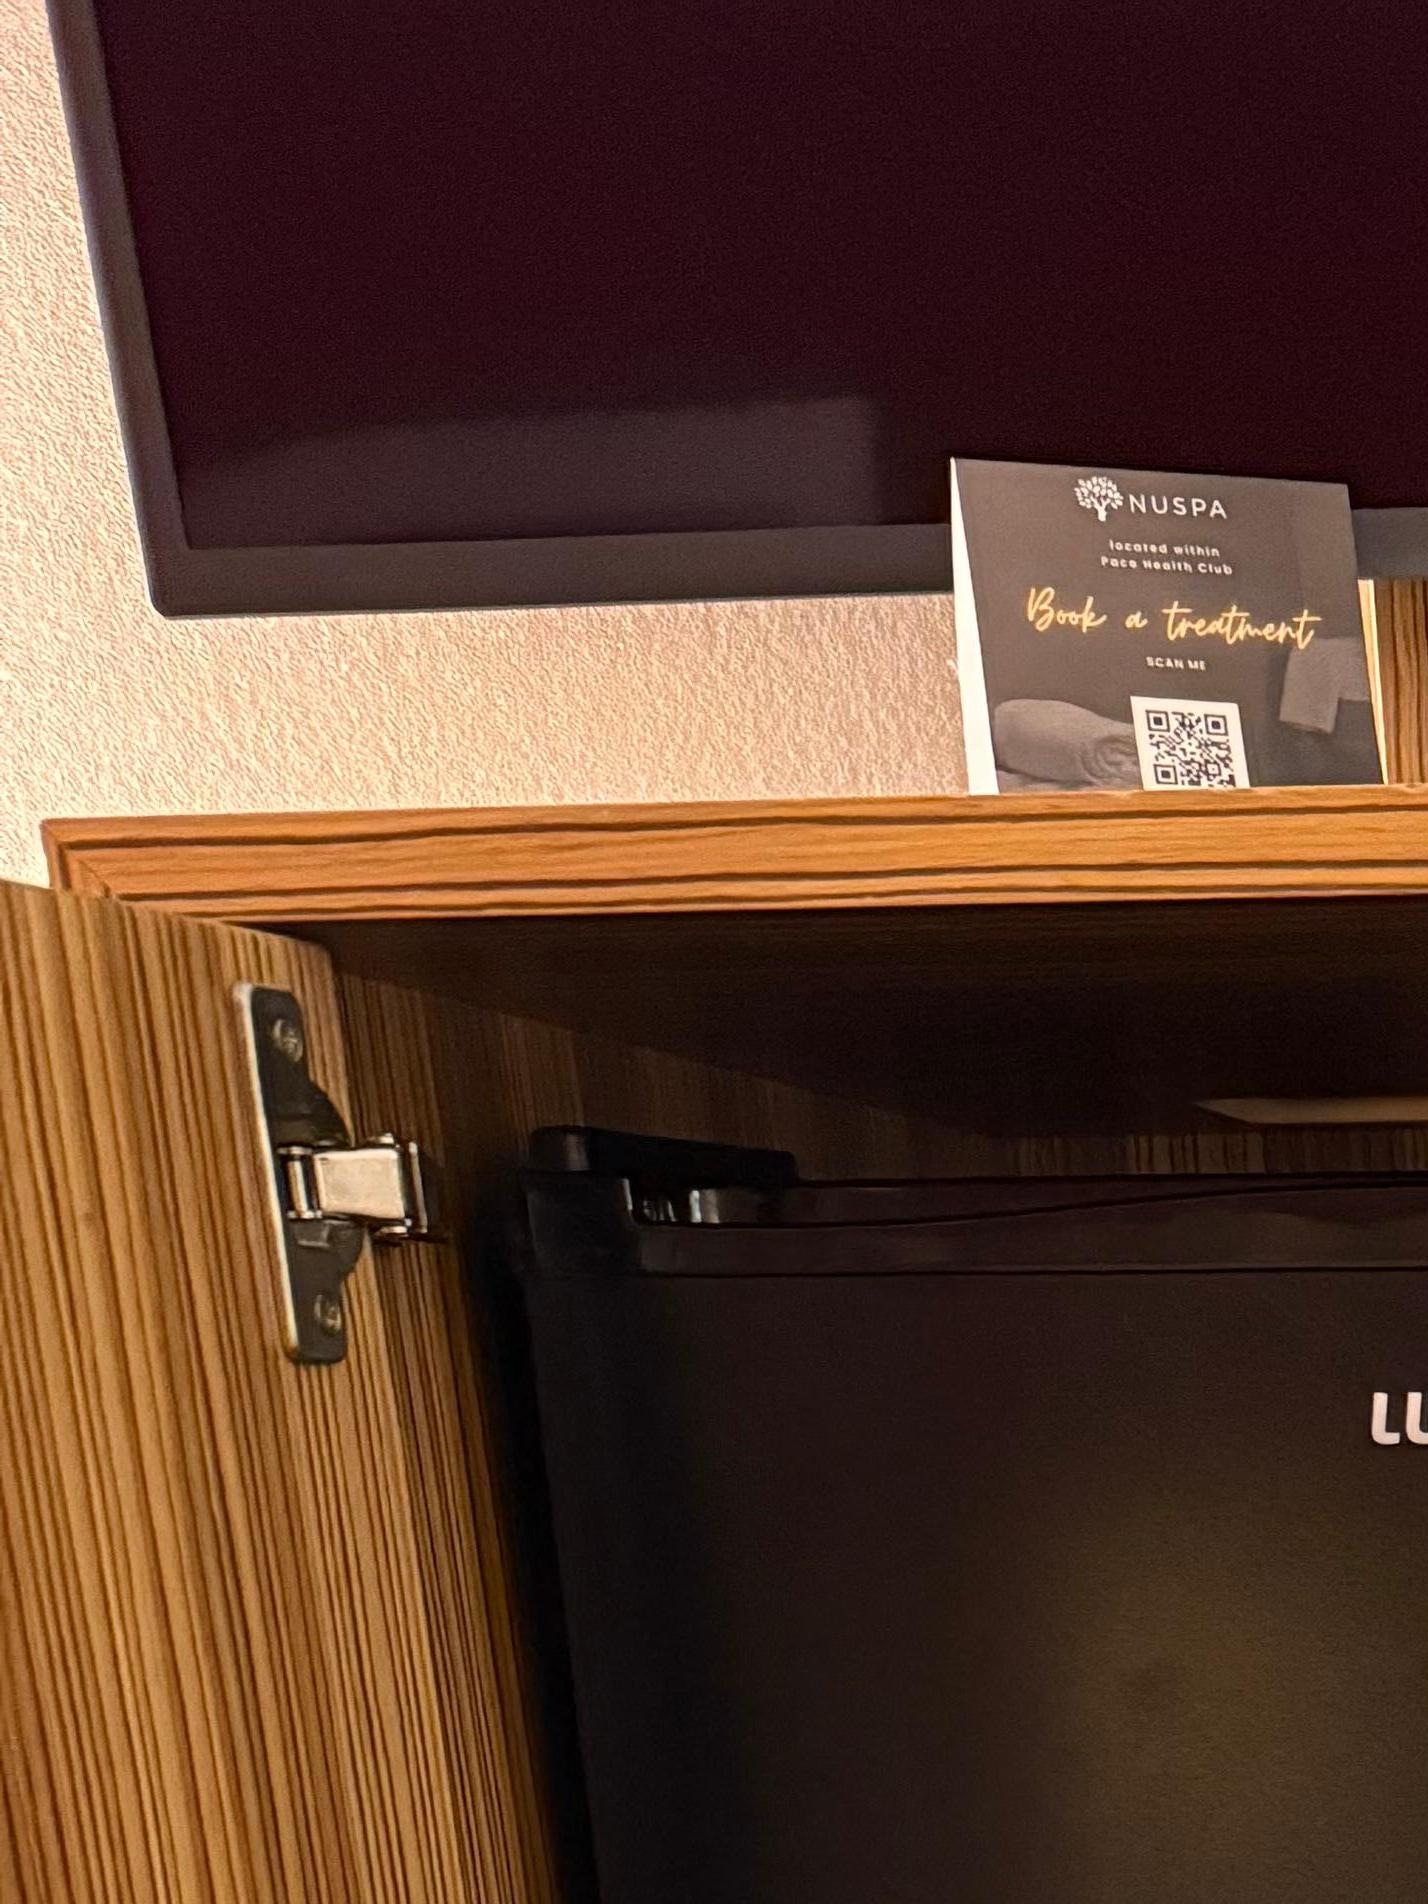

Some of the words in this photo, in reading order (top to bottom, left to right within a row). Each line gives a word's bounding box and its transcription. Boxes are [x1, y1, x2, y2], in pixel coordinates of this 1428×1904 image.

[1128, 493, 1228, 520] NUSPA
[1108, 538, 1168, 555] located
[1173, 543, 1220, 558] within
[1142, 558, 1194, 574] Health
[1197, 562, 1233, 576] Club
[1026, 586, 1108, 633] Book
[1124, 609, 1149, 629] a
[1161, 599, 1322, 650] treatment
[1145, 655, 1185, 670] SCAN
[1186, 658, 1207, 672] ME
